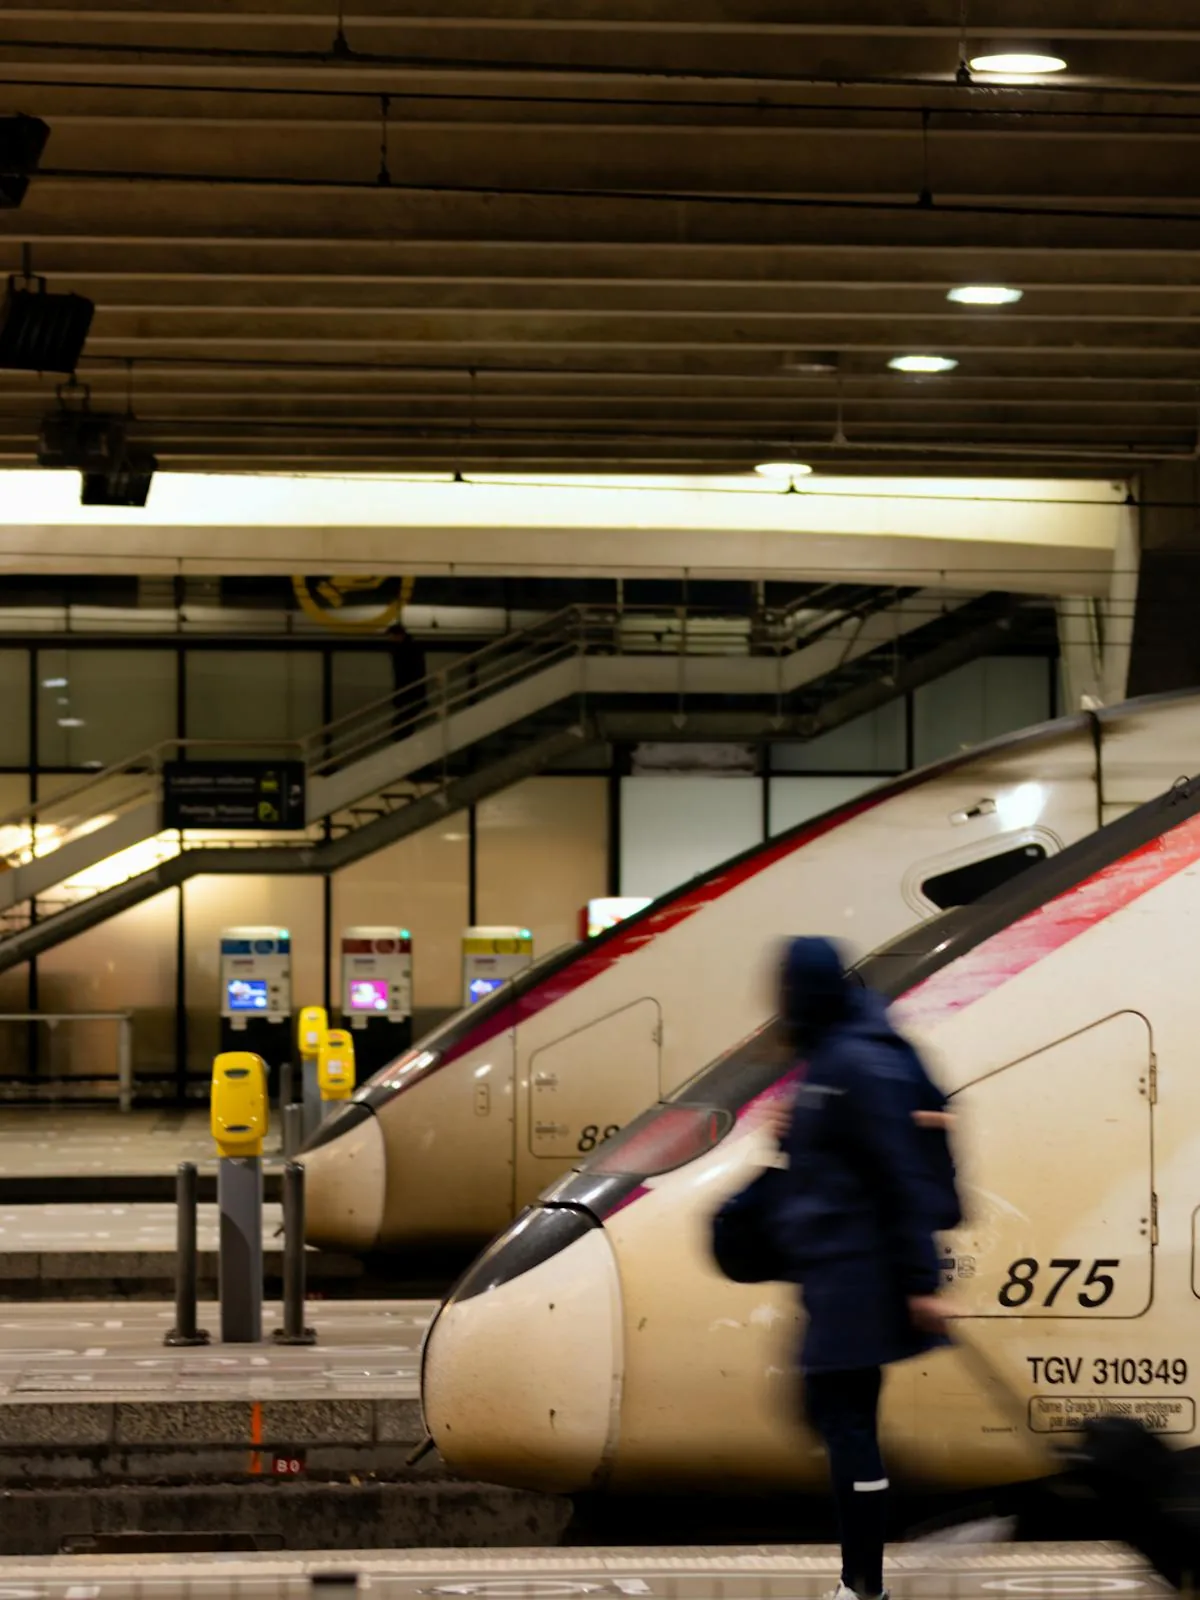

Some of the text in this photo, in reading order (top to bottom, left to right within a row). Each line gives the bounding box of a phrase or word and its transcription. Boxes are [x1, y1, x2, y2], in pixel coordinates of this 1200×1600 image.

[998, 1257, 1120, 1308] 875
[1027, 1357, 1188, 1385] TGV 310349
